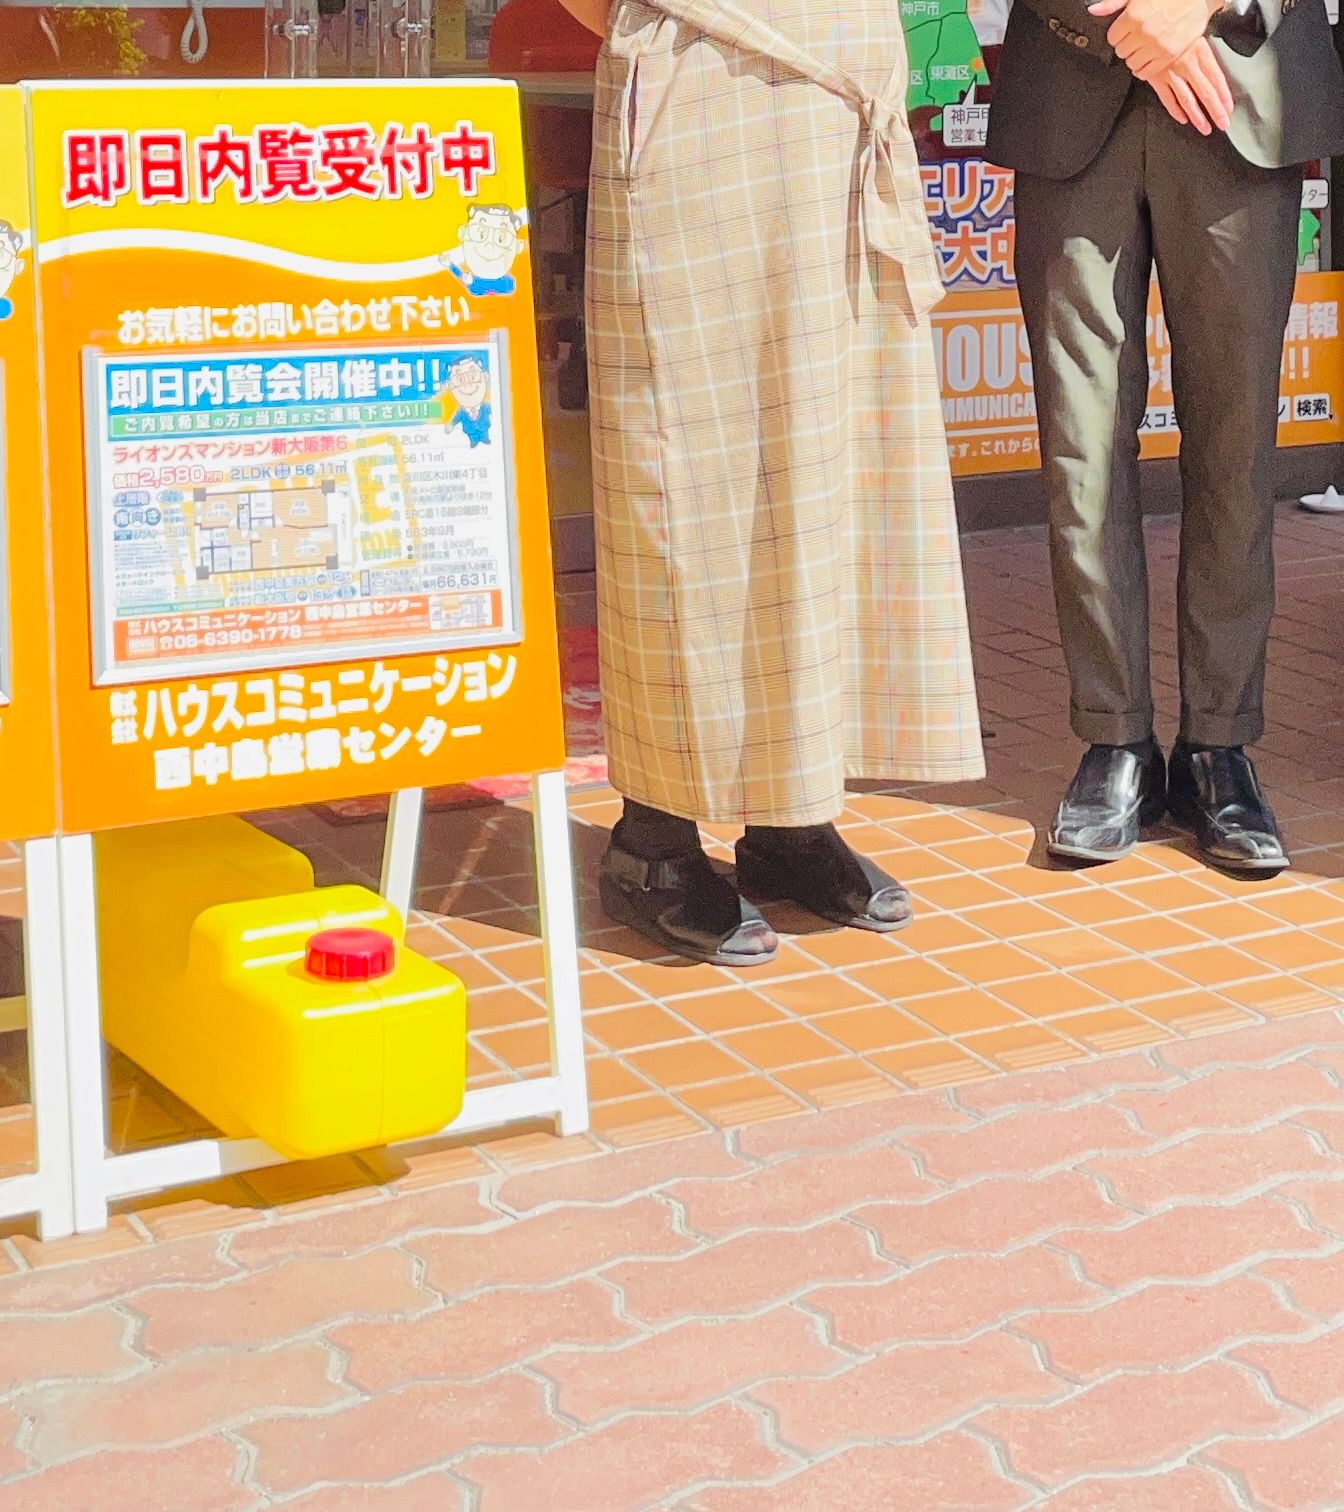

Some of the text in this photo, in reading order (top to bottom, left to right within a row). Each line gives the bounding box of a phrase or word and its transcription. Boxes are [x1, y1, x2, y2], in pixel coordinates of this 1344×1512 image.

[63, 125, 495, 206] 即日内覧受付中
[116, 294, 470, 346] お気軽にお問い合わせ下さい
[109, 357, 443, 410] 即日内覧会開催中!!
[143, 652, 517, 742] ハウスコミュニケーション
